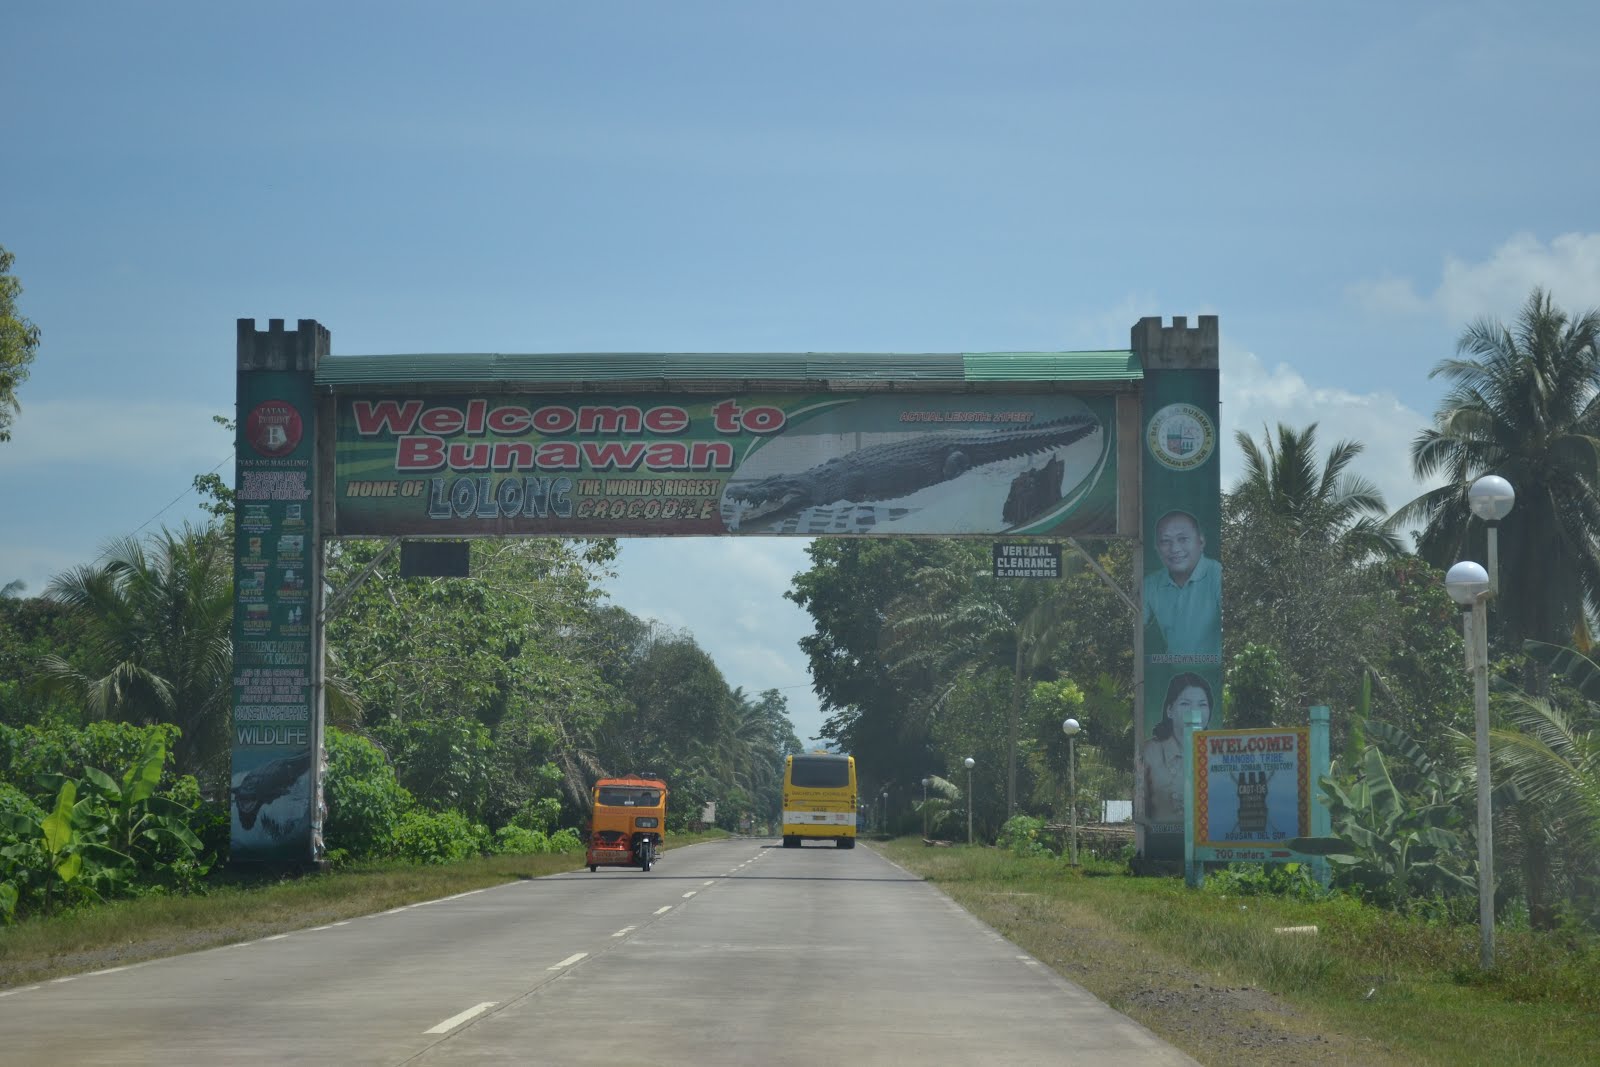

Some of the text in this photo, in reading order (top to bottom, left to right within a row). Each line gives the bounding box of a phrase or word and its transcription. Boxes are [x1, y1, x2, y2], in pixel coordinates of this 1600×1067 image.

[352, 399, 787, 435] Welcome to
[900, 412, 943, 422] ACTUAL
[396, 435, 734, 471] Bunawan
[346, 480, 424, 497] HOME OF
[577, 480, 720, 496] THE WORLD'S BIGGEST
[429, 476, 573, 520] LOLONG
[576, 499, 718, 520] CROCODILE
[1002, 545, 1052, 556] VERTICAL
[997, 557, 1057, 568] CLEARANCE
[237, 726, 307, 745] WILDLIFE
[1209, 736, 1294, 754] WELCOME
[1260, 753, 1284, 763] TRIBE
[1225, 832, 1253, 840] AGUSAN
[1257, 832, 1269, 840] DEL
